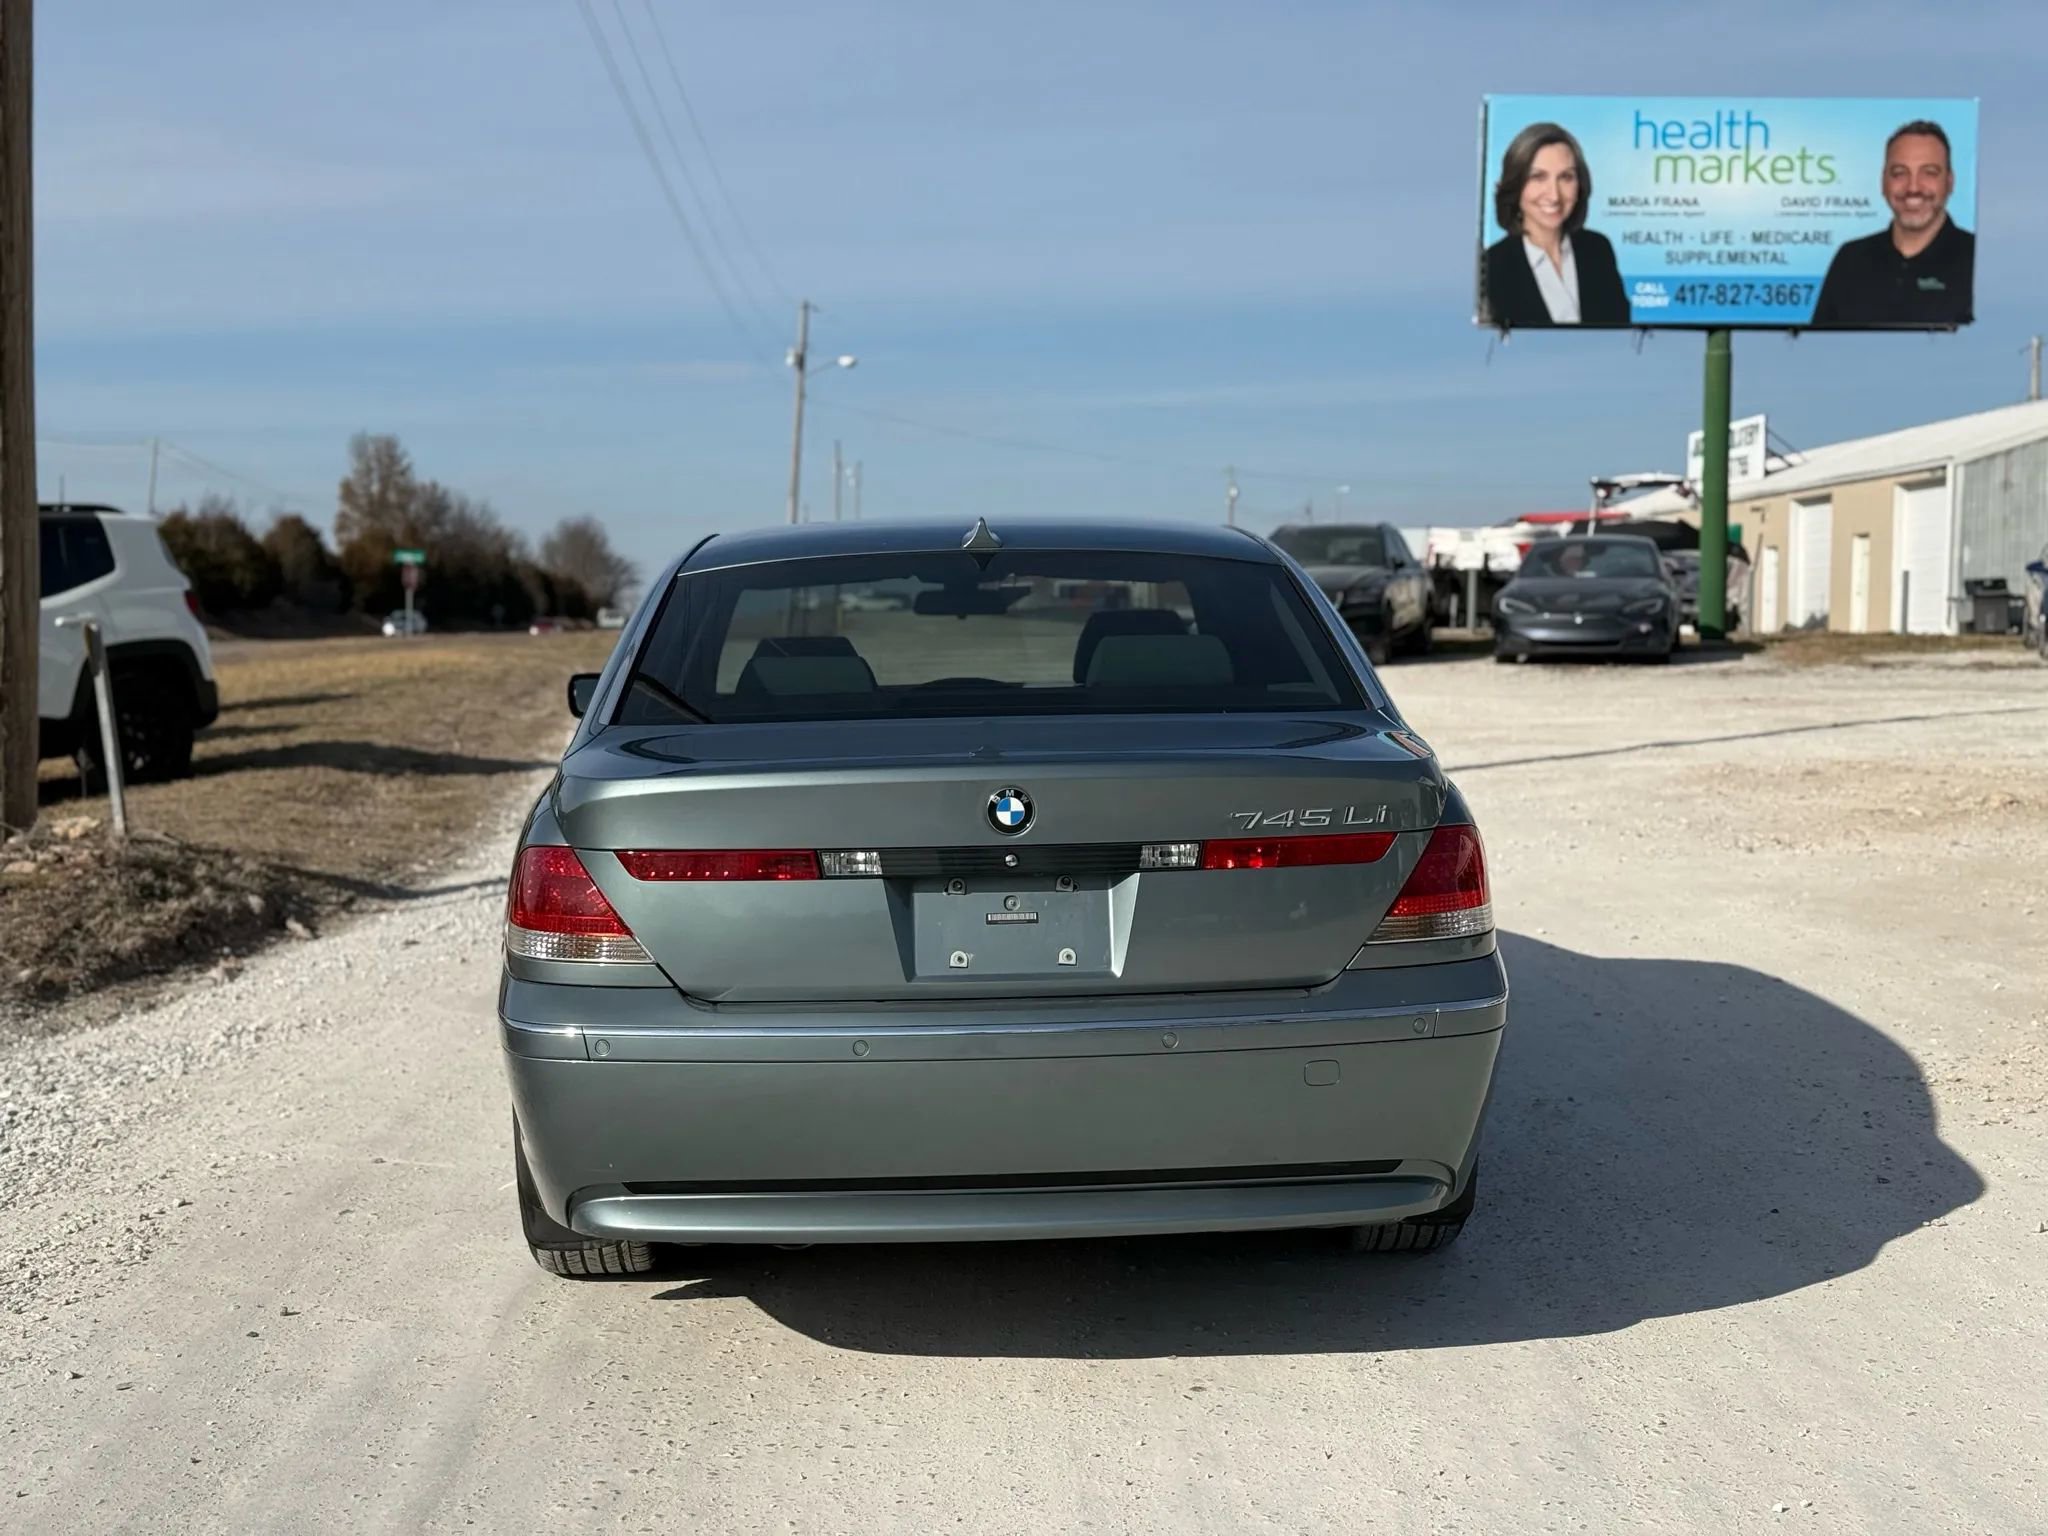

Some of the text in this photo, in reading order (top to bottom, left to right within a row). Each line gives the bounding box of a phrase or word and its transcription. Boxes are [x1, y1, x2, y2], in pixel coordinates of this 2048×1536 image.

[1633, 109, 1769, 150] health
[1654, 145, 1836, 184] markets
[1781, 196, 1821, 207] DAVID
[1621, 231, 1833, 245] HEALTH LIFE MEDICARE
[1665, 250, 1788, 265] SUPPLEMENTAL
[1675, 283, 1815, 306] 417-827-3667
[1231, 804, 1388, 830] 745 Li
